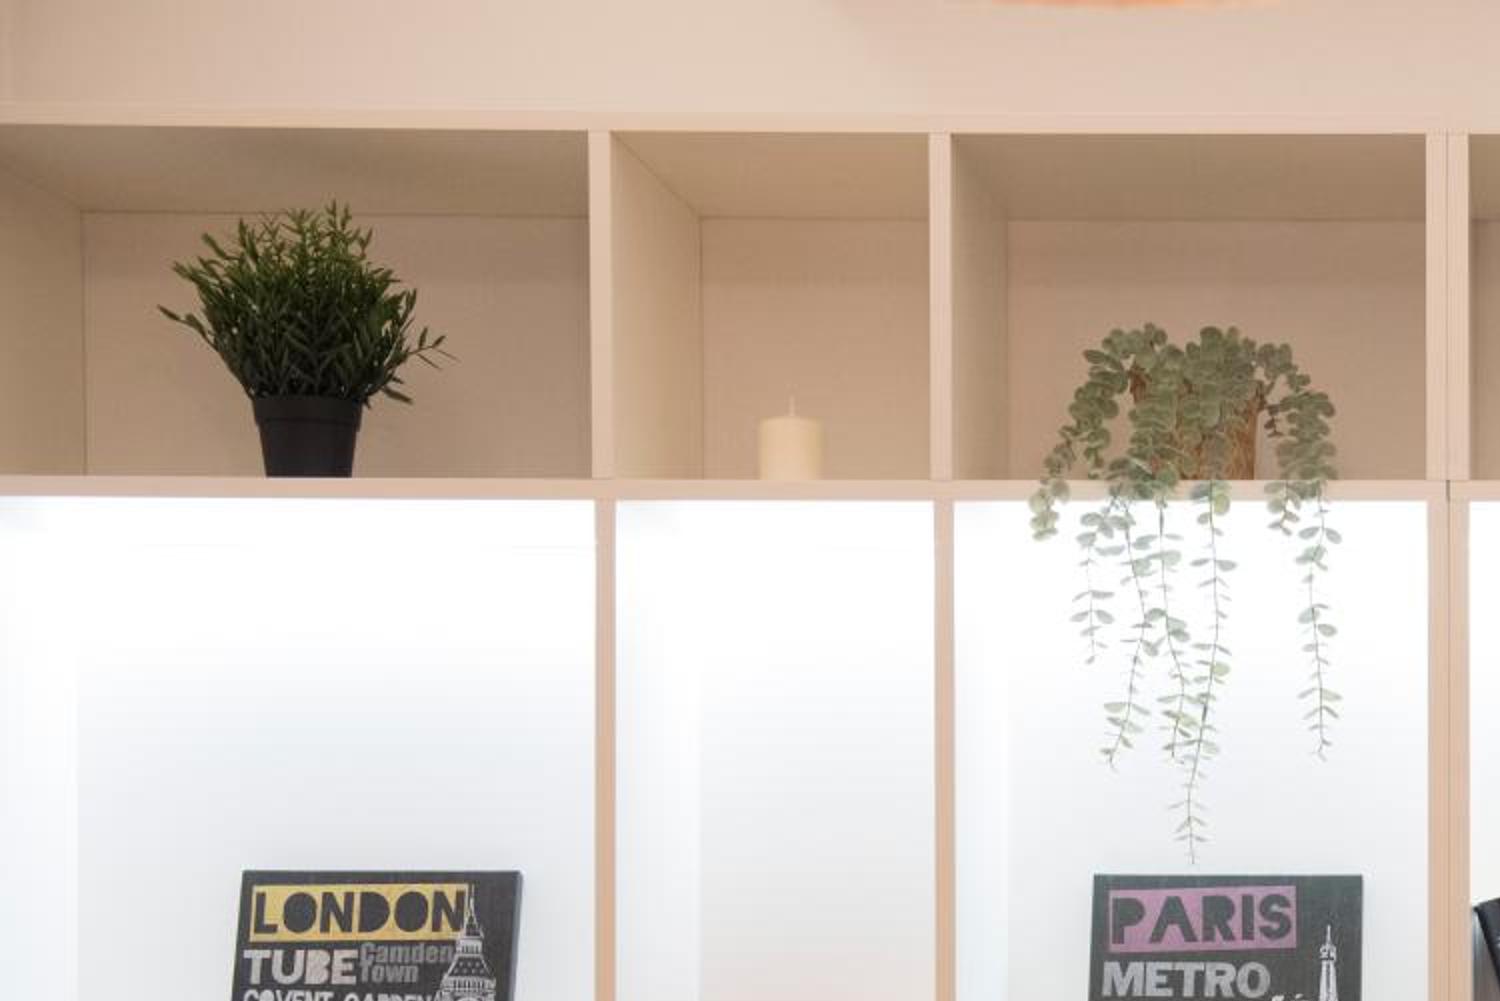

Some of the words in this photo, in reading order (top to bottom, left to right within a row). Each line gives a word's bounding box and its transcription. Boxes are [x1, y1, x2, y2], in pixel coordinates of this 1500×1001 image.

[254, 891, 465, 934] LONDON
[1112, 894, 1292, 944] PARIS
[243, 949, 357, 985] TUBE
[359, 943, 450, 964] Camden
[360, 964, 418, 983] Town
[1102, 961, 1271, 998] METRO
